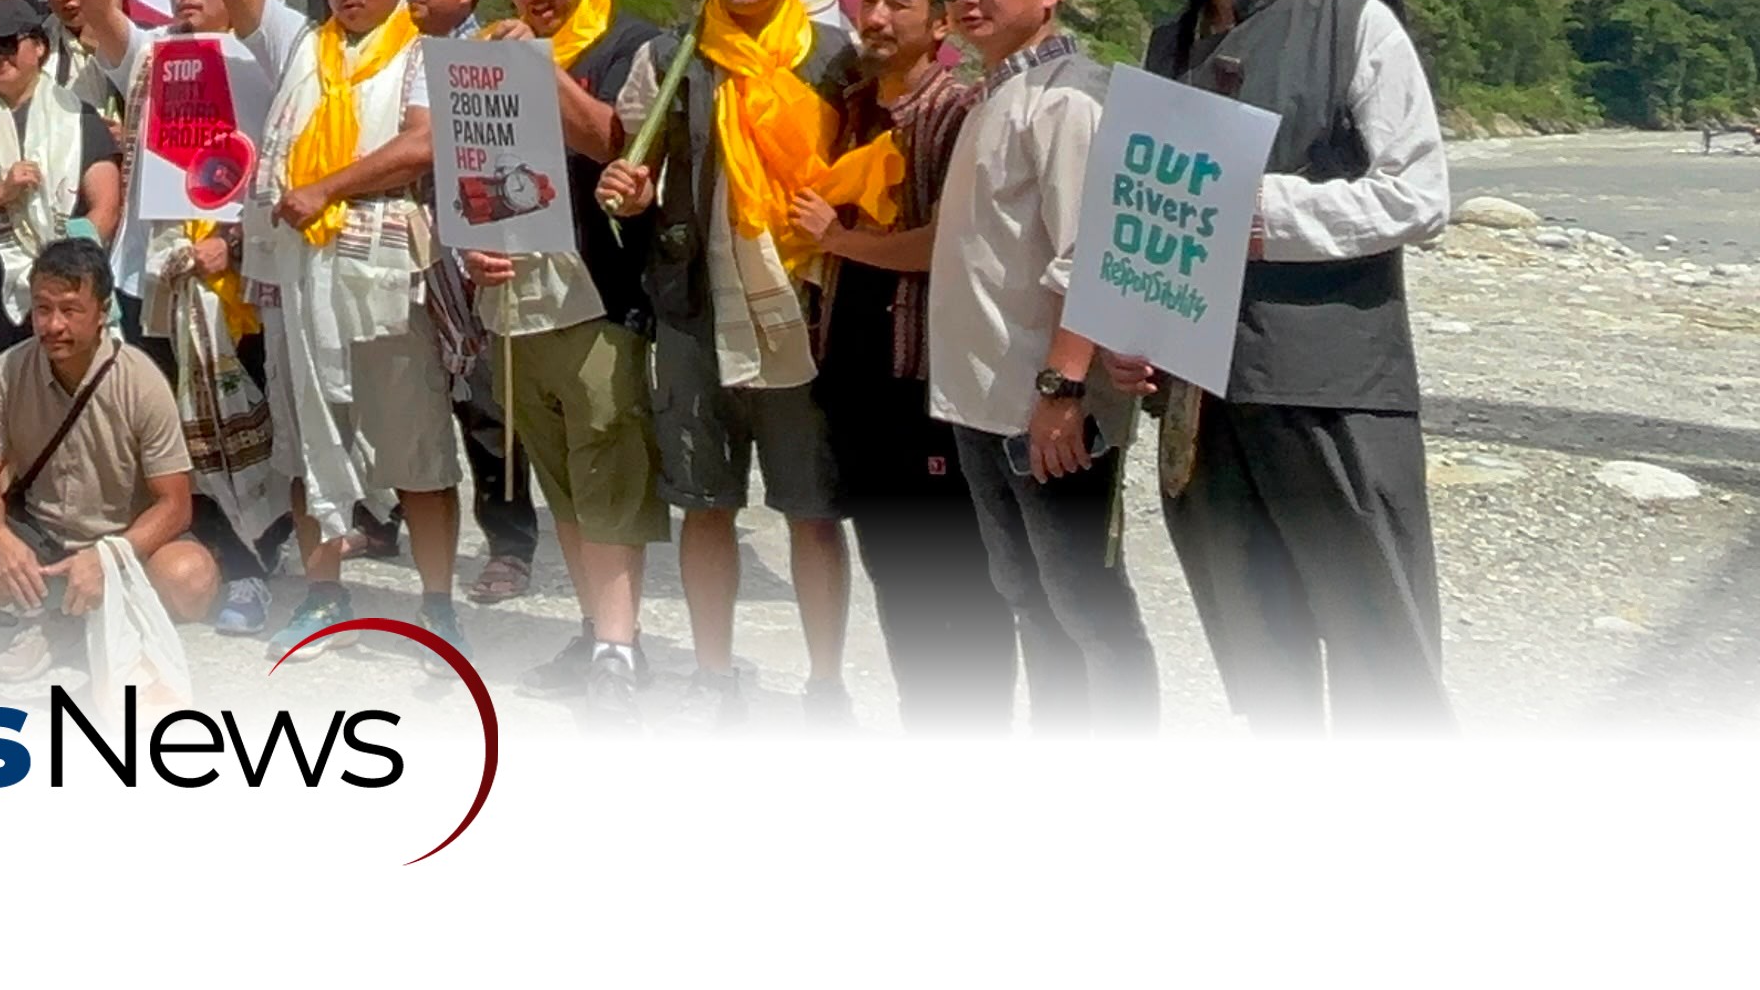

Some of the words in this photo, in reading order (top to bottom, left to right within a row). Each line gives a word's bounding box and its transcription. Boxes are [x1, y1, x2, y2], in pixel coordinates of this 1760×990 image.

[162, 59, 203, 82] STOP
[448, 63, 504, 90] SCRAP
[450, 92, 482, 116] 280
[484, 94, 520, 119] MW
[158, 125, 232, 149] PROJECT
[452, 119, 515, 146] PANAM
[455, 146, 487, 171] HEP
